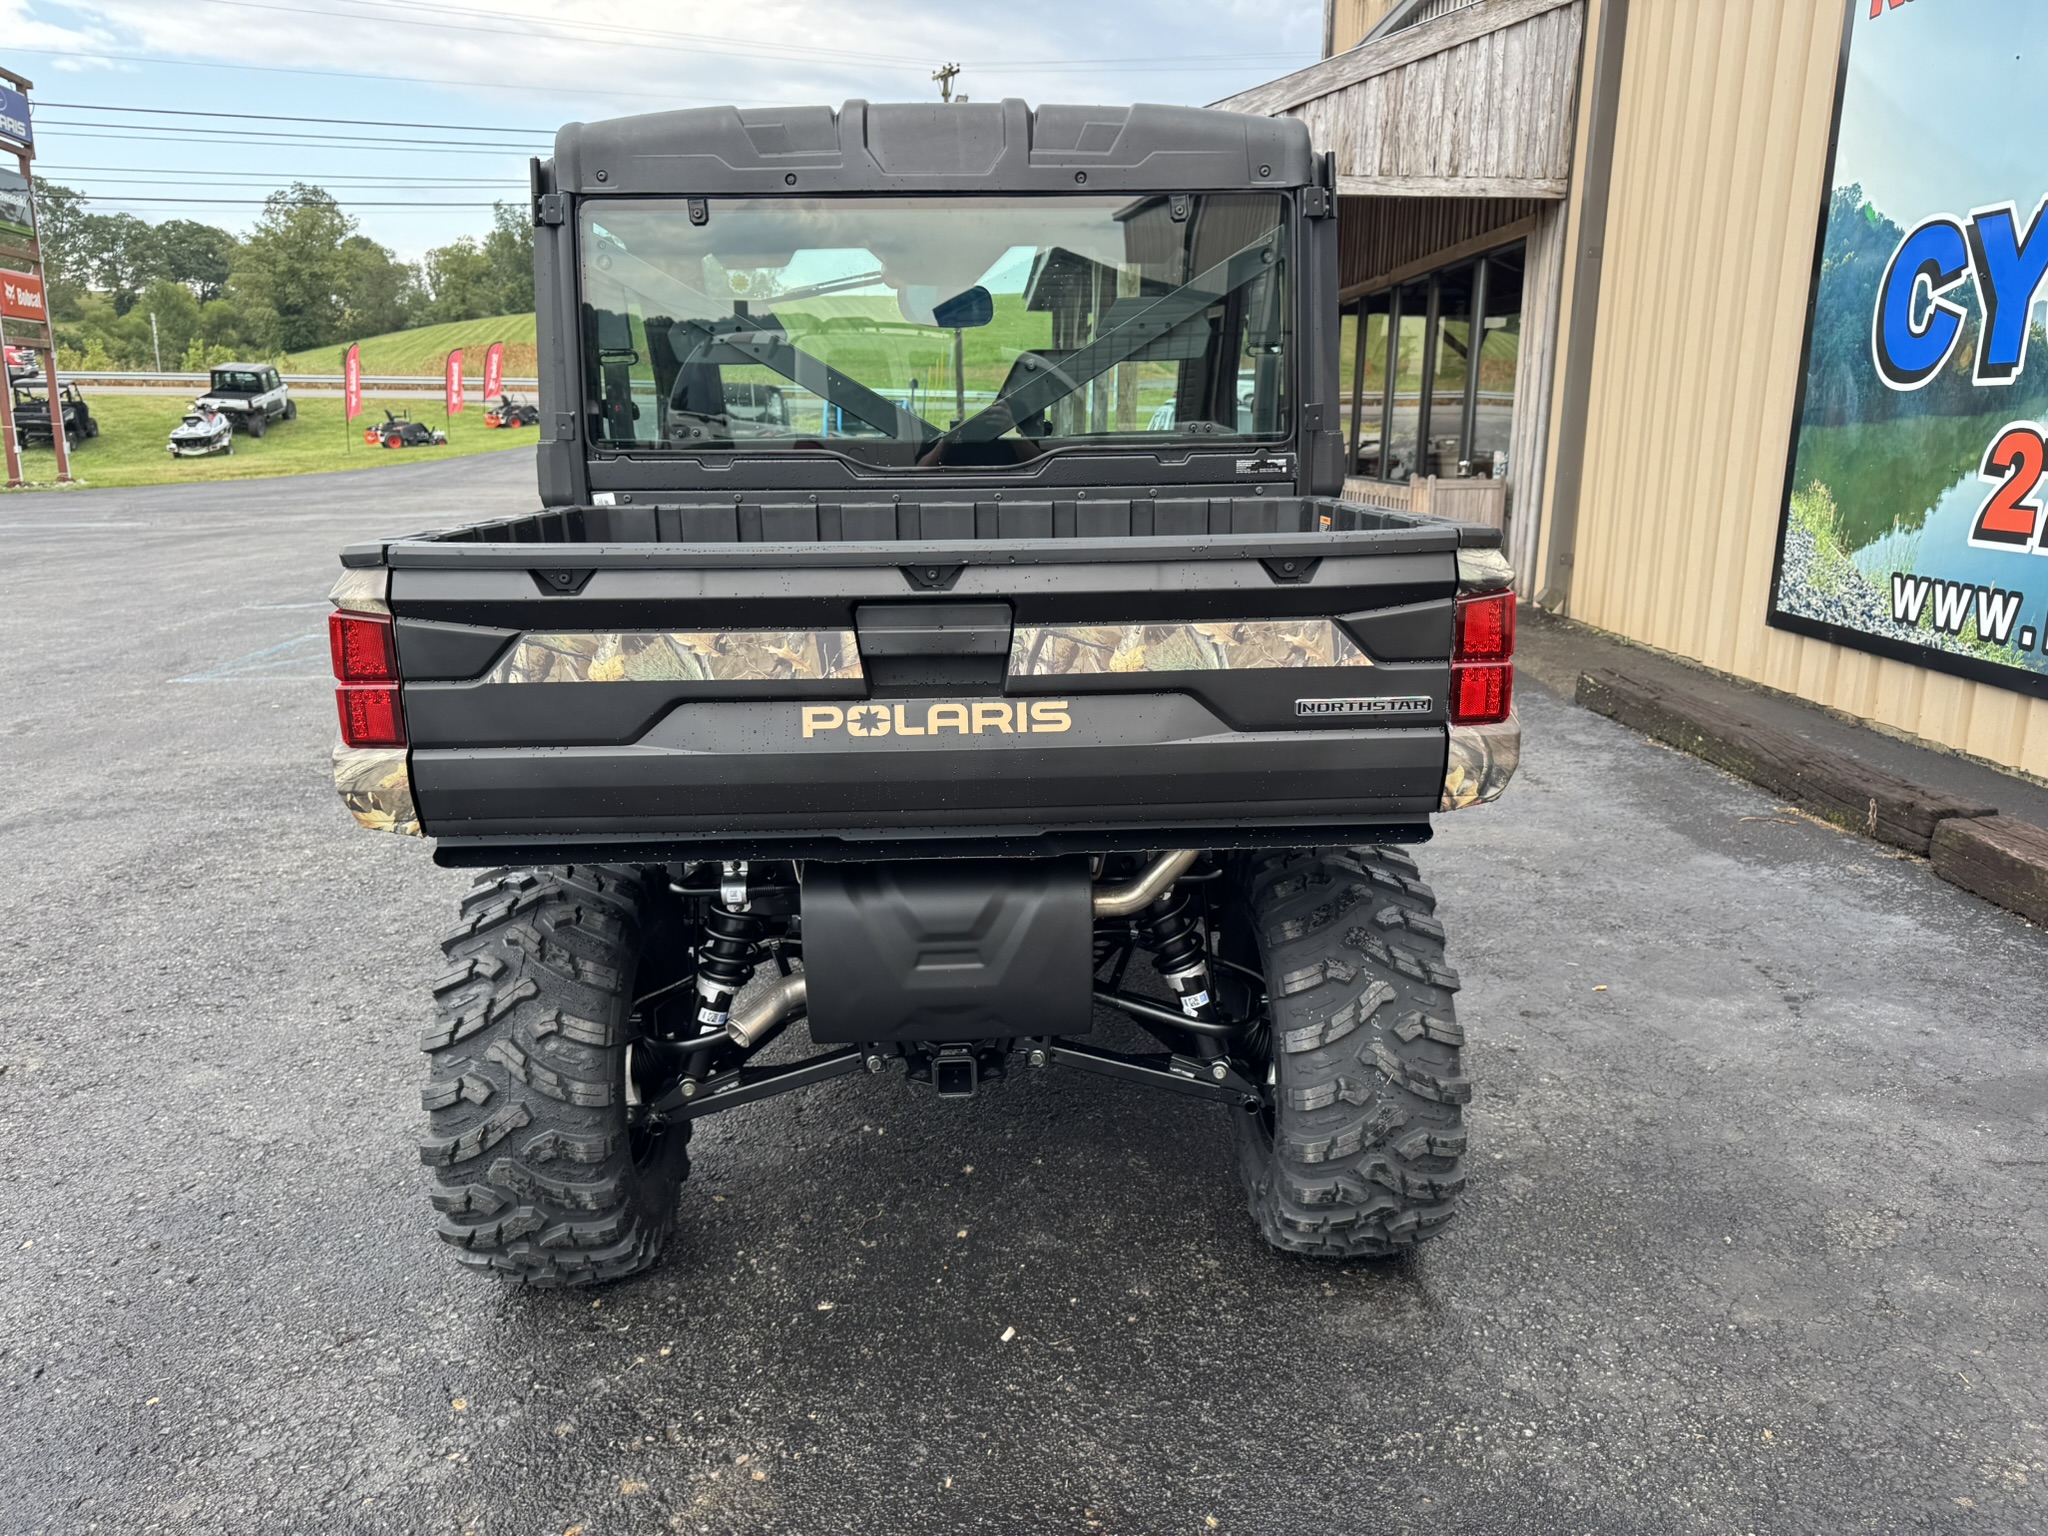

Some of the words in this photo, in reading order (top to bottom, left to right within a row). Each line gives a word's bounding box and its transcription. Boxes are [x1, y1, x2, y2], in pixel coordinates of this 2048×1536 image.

[16, 287, 42, 308] Bobcat
[1873, 195, 2048, 388] CY
[1971, 426, 2048, 548] 2
[801, 701, 1072, 738] POLARIS
[1302, 700, 1427, 713] NORTHSTAR
